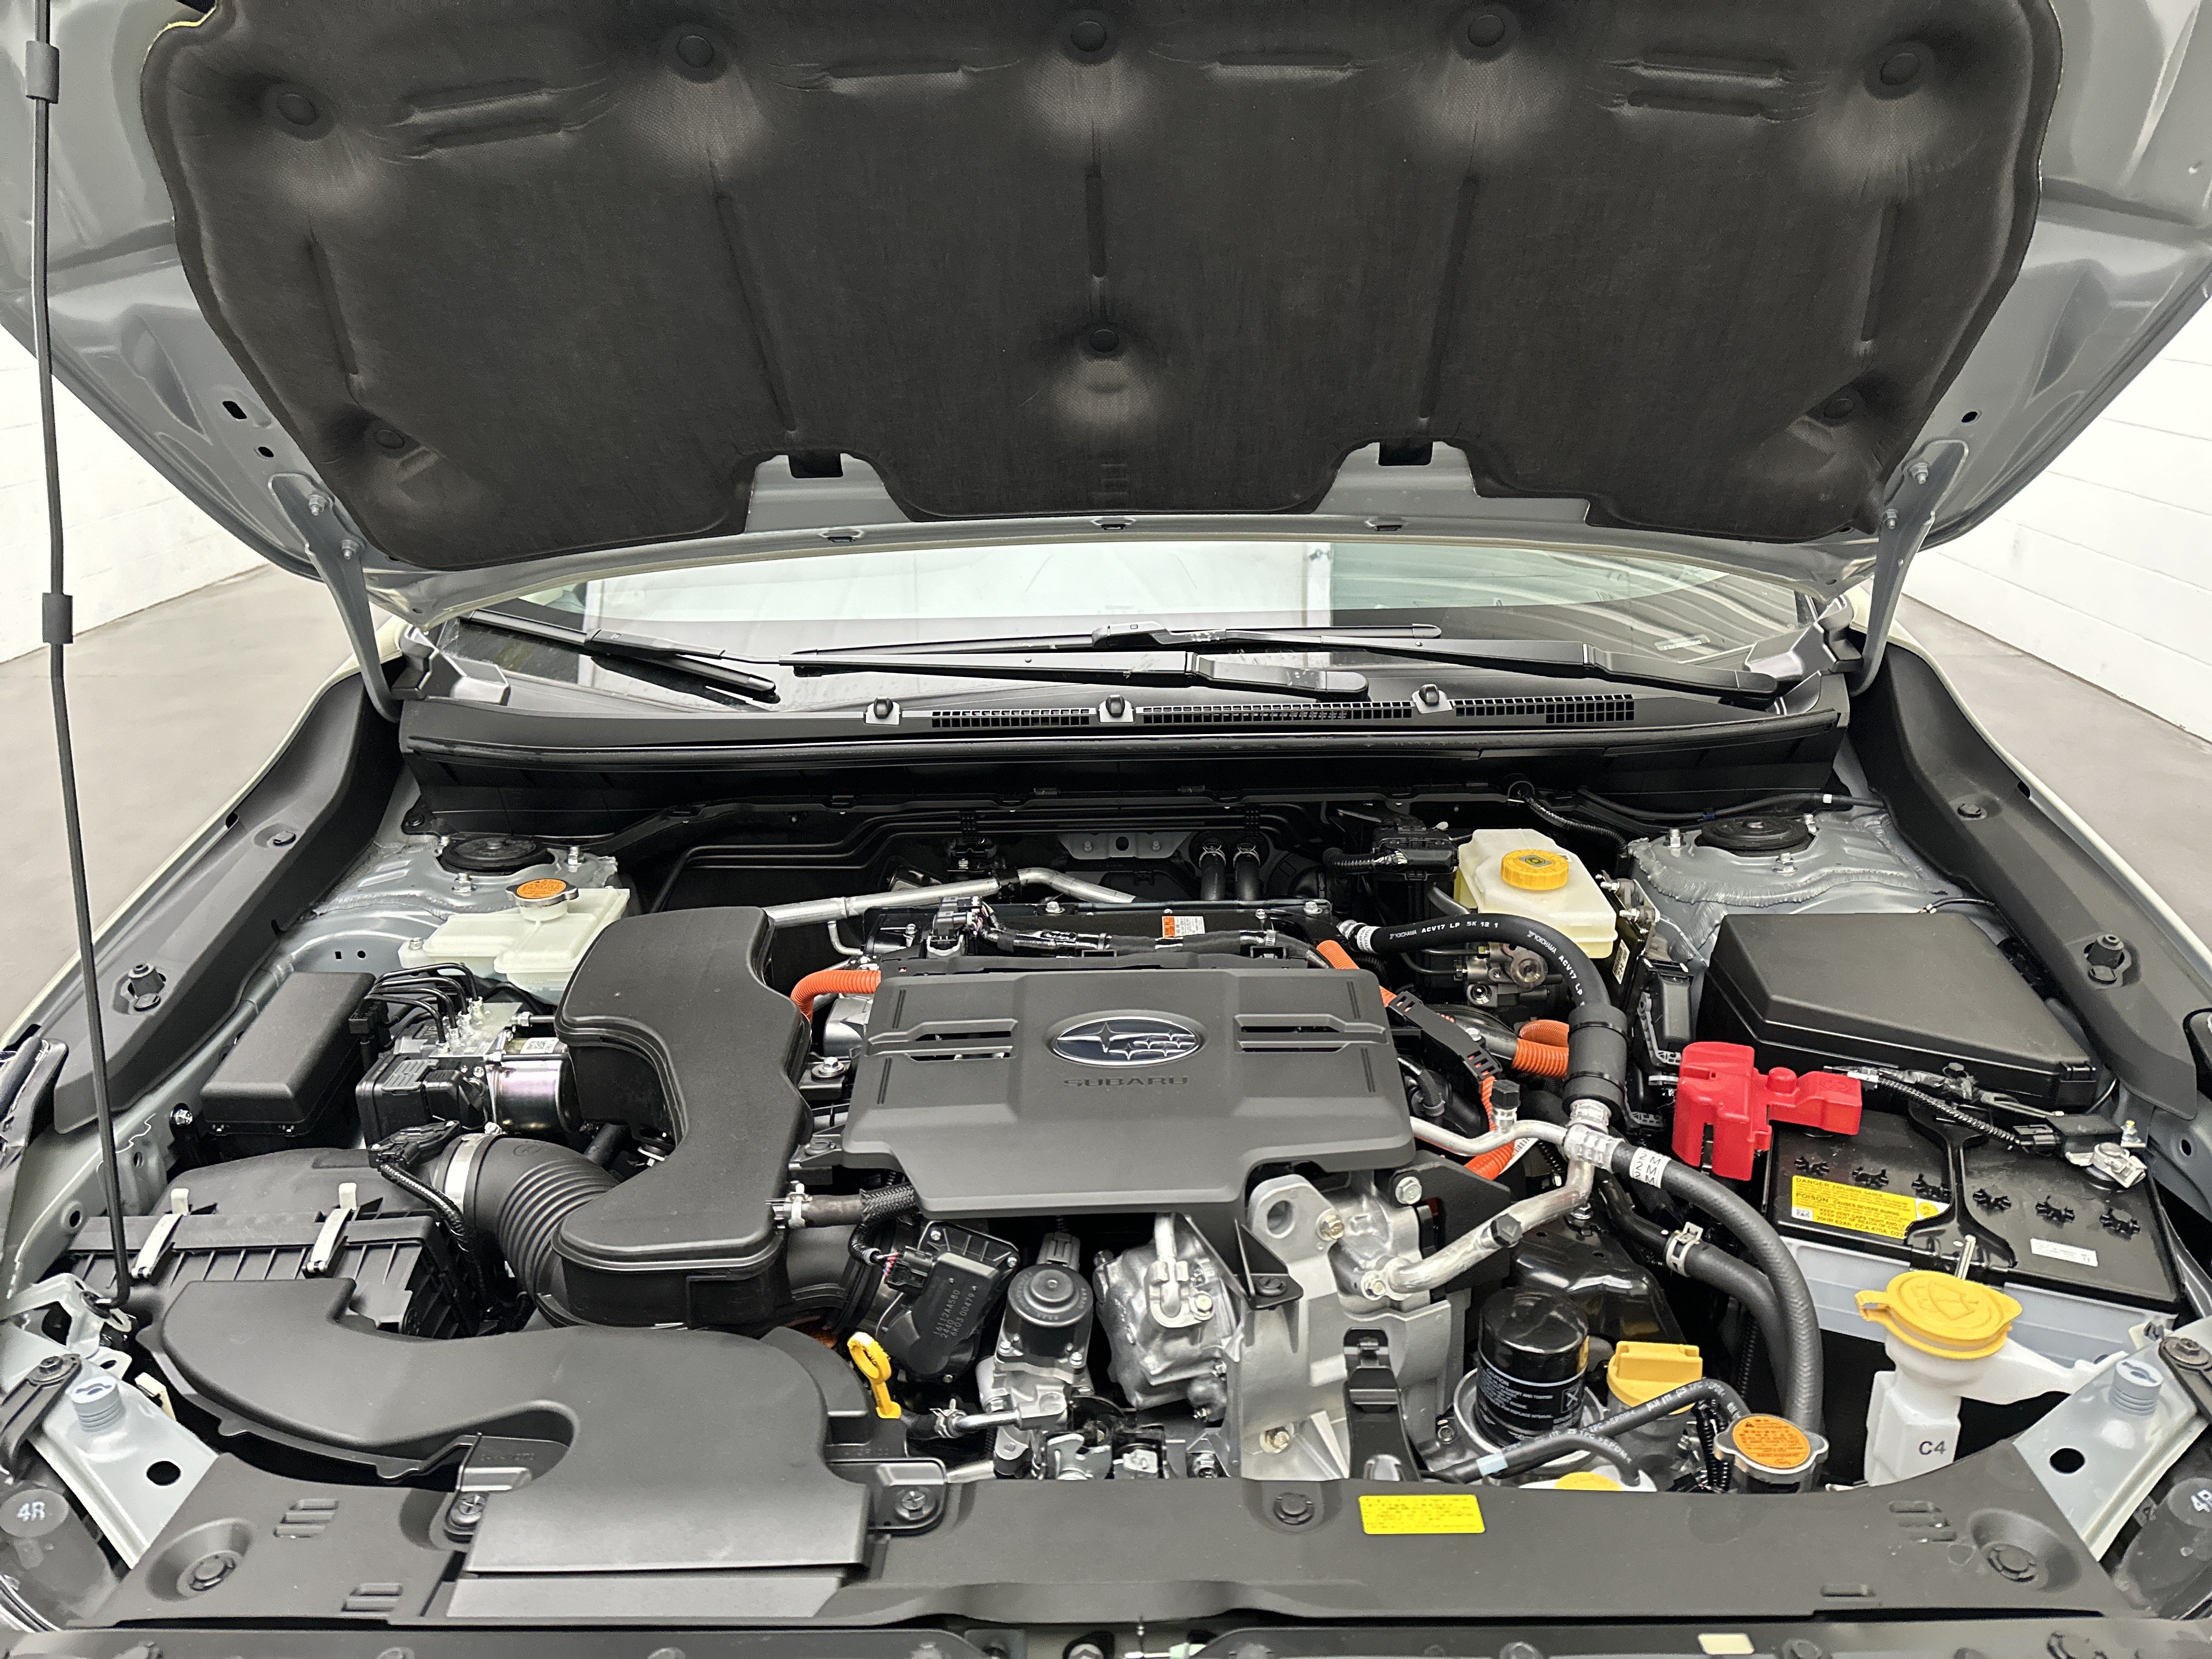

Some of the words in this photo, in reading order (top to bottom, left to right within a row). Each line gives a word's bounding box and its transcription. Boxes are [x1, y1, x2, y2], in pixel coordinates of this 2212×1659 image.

[1395, 930, 1417, 938] YOKOHAMA
[1421, 924, 1446, 933] ACV17
[1534, 934, 1557, 954] YOKOHAMA
[1559, 955, 1577, 979] ACV17
[1575, 983, 1583, 995] LP
[1063, 1076, 1188, 1087] SUBARU
[1796, 1178, 1830, 1187] DANGER
[1796, 1192, 1829, 1203] POISON
[940, 1319, 955, 1339] 2440
[950, 1317, 964, 1336] 6K03
[1486, 1368, 1509, 1386] CAUTION
[1919, 1440, 1946, 1455] C4
[17, 1501, 46, 1522] 4R
